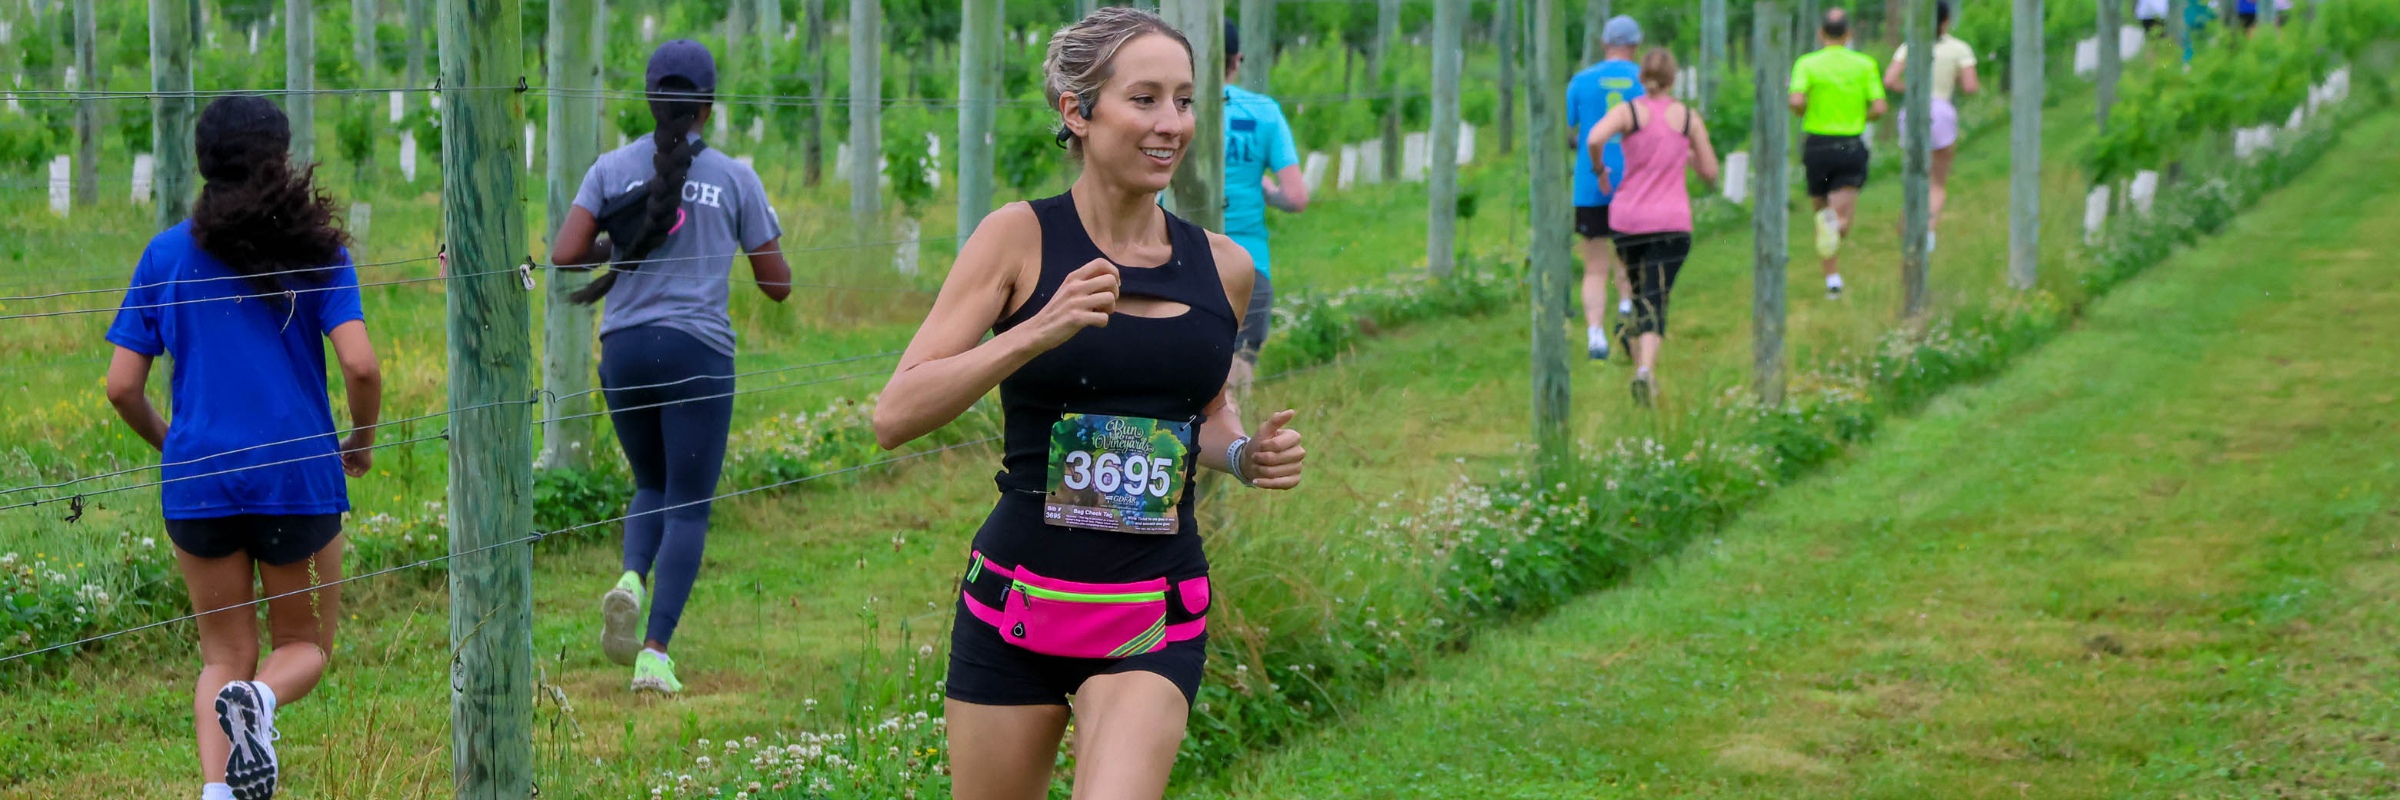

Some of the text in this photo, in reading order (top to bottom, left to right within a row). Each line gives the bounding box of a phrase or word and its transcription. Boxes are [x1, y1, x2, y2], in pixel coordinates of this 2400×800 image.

[1105, 419, 1144, 439] Run
[1095, 433, 1154, 454] Vineyards
[1064, 450, 1173, 497] 3695
[1085, 509, 1102, 517] Check
